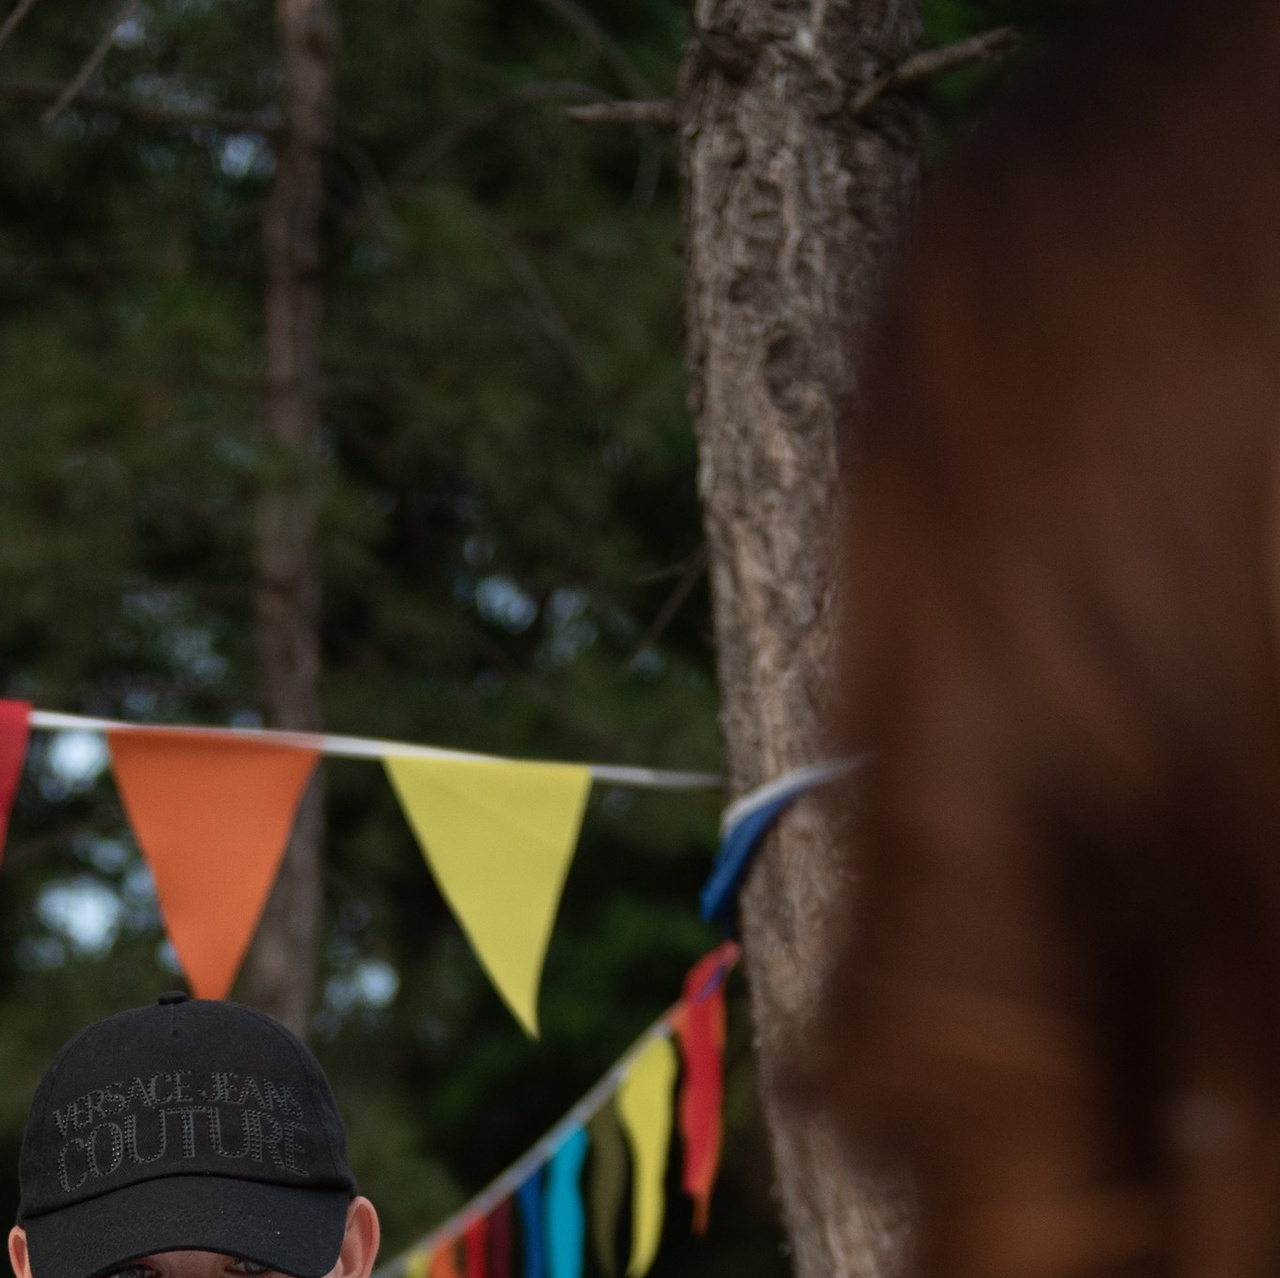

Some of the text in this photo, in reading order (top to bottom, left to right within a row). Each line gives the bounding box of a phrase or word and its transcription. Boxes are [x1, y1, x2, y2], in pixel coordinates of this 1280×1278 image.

[53, 1070, 304, 1140] VERSACE JEANS
[56, 1105, 310, 1193] COUTURE
